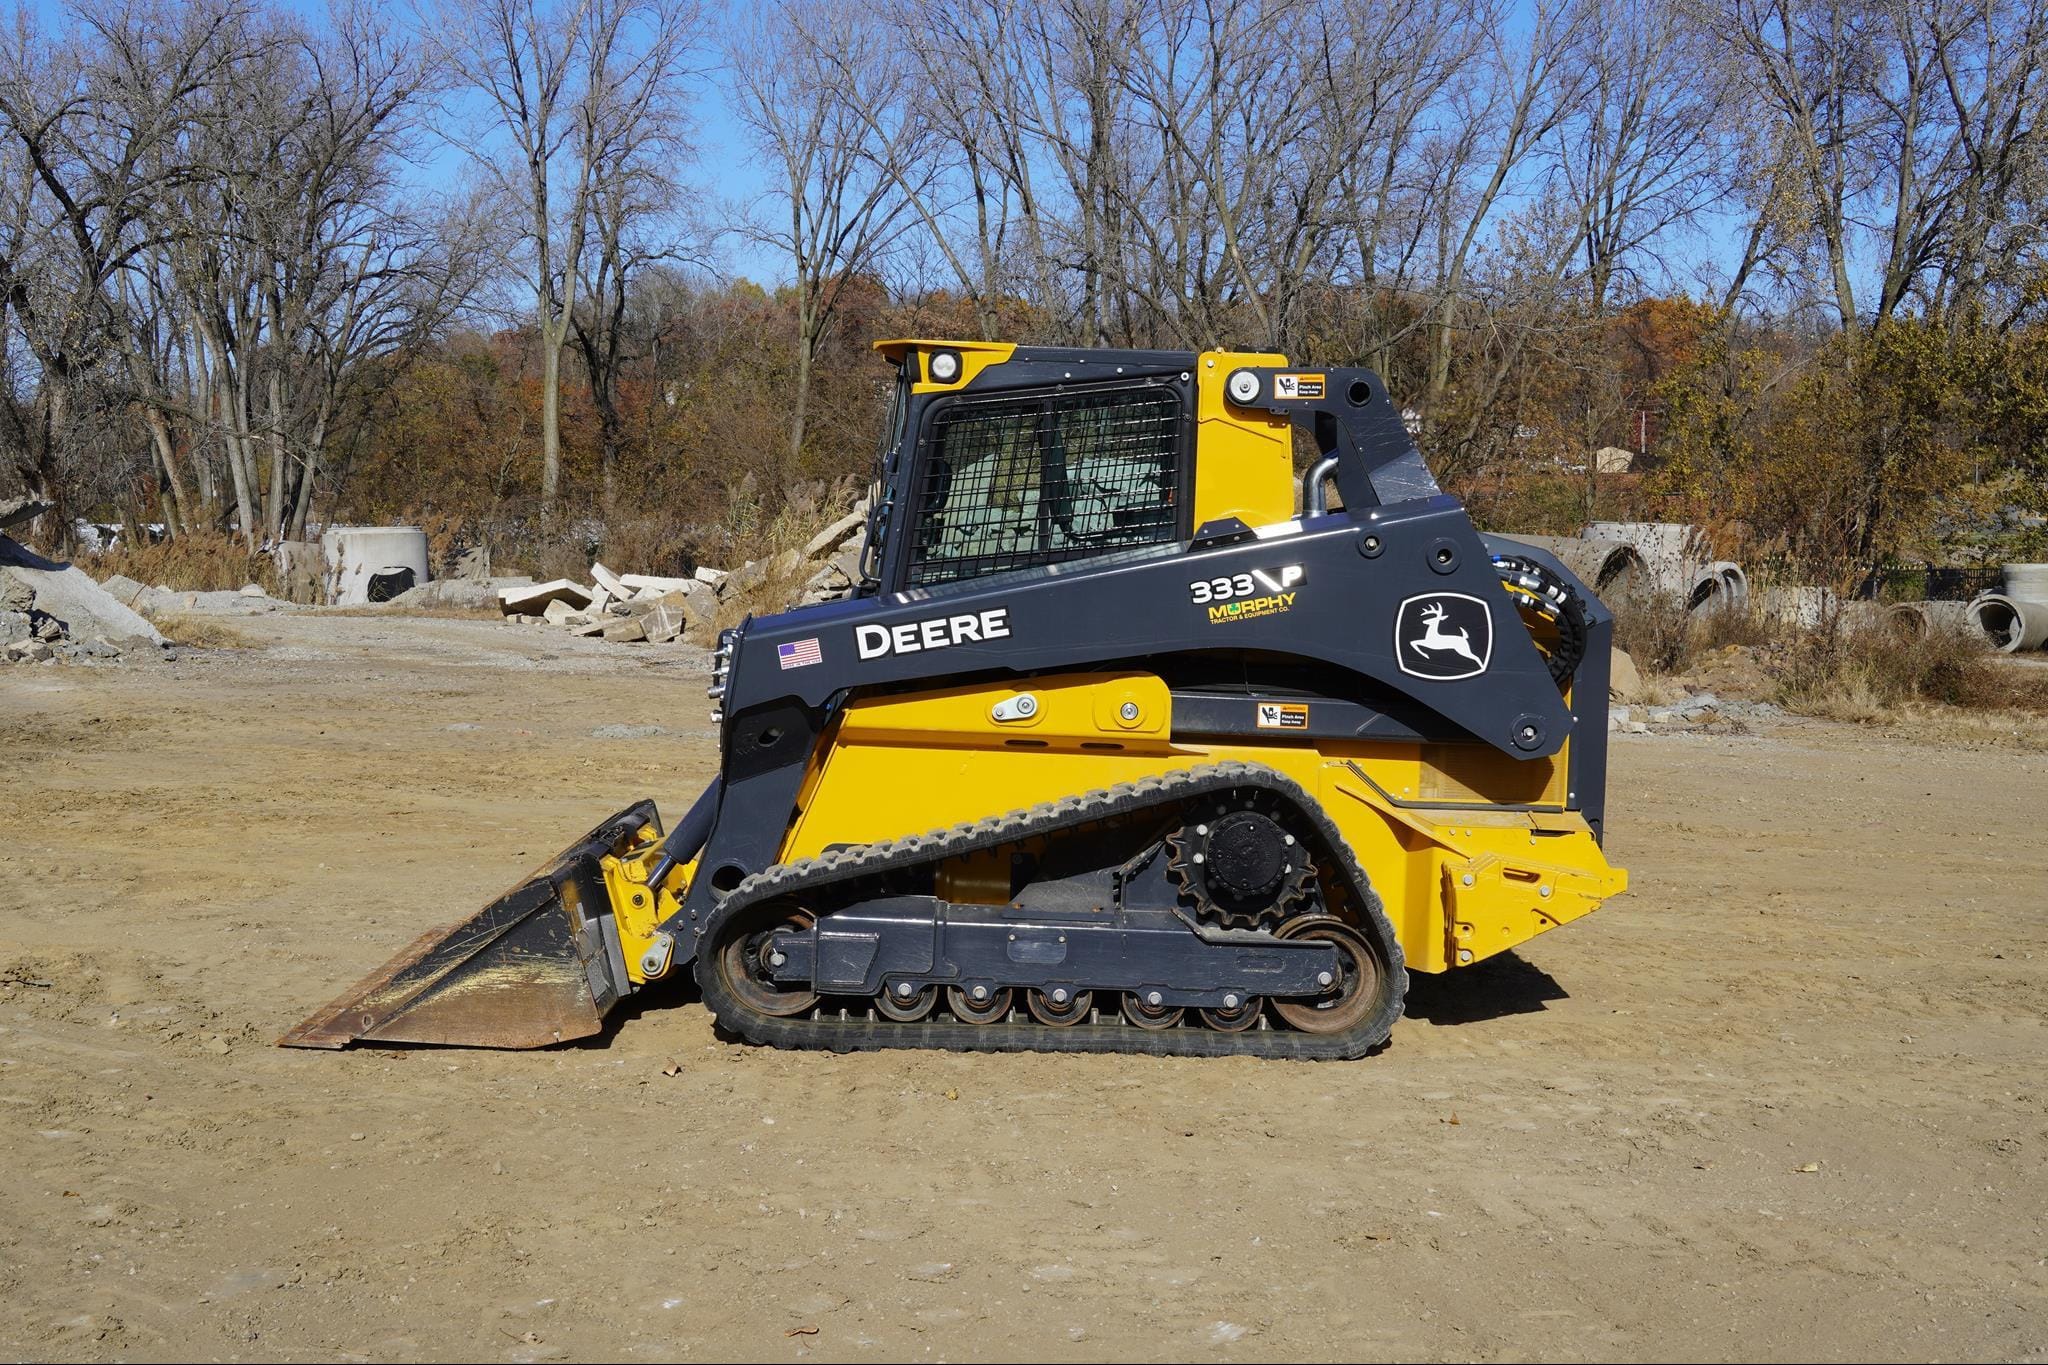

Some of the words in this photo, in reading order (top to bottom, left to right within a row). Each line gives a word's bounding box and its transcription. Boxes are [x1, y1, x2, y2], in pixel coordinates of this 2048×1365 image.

[1190, 573, 1255, 604] 333
[1207, 591, 1297, 620] MURPHY
[1209, 615, 1239, 625] TRACTOR
[1244, 608, 1278, 619] EQUIPMENT
[855, 608, 1010, 660] DEERE
